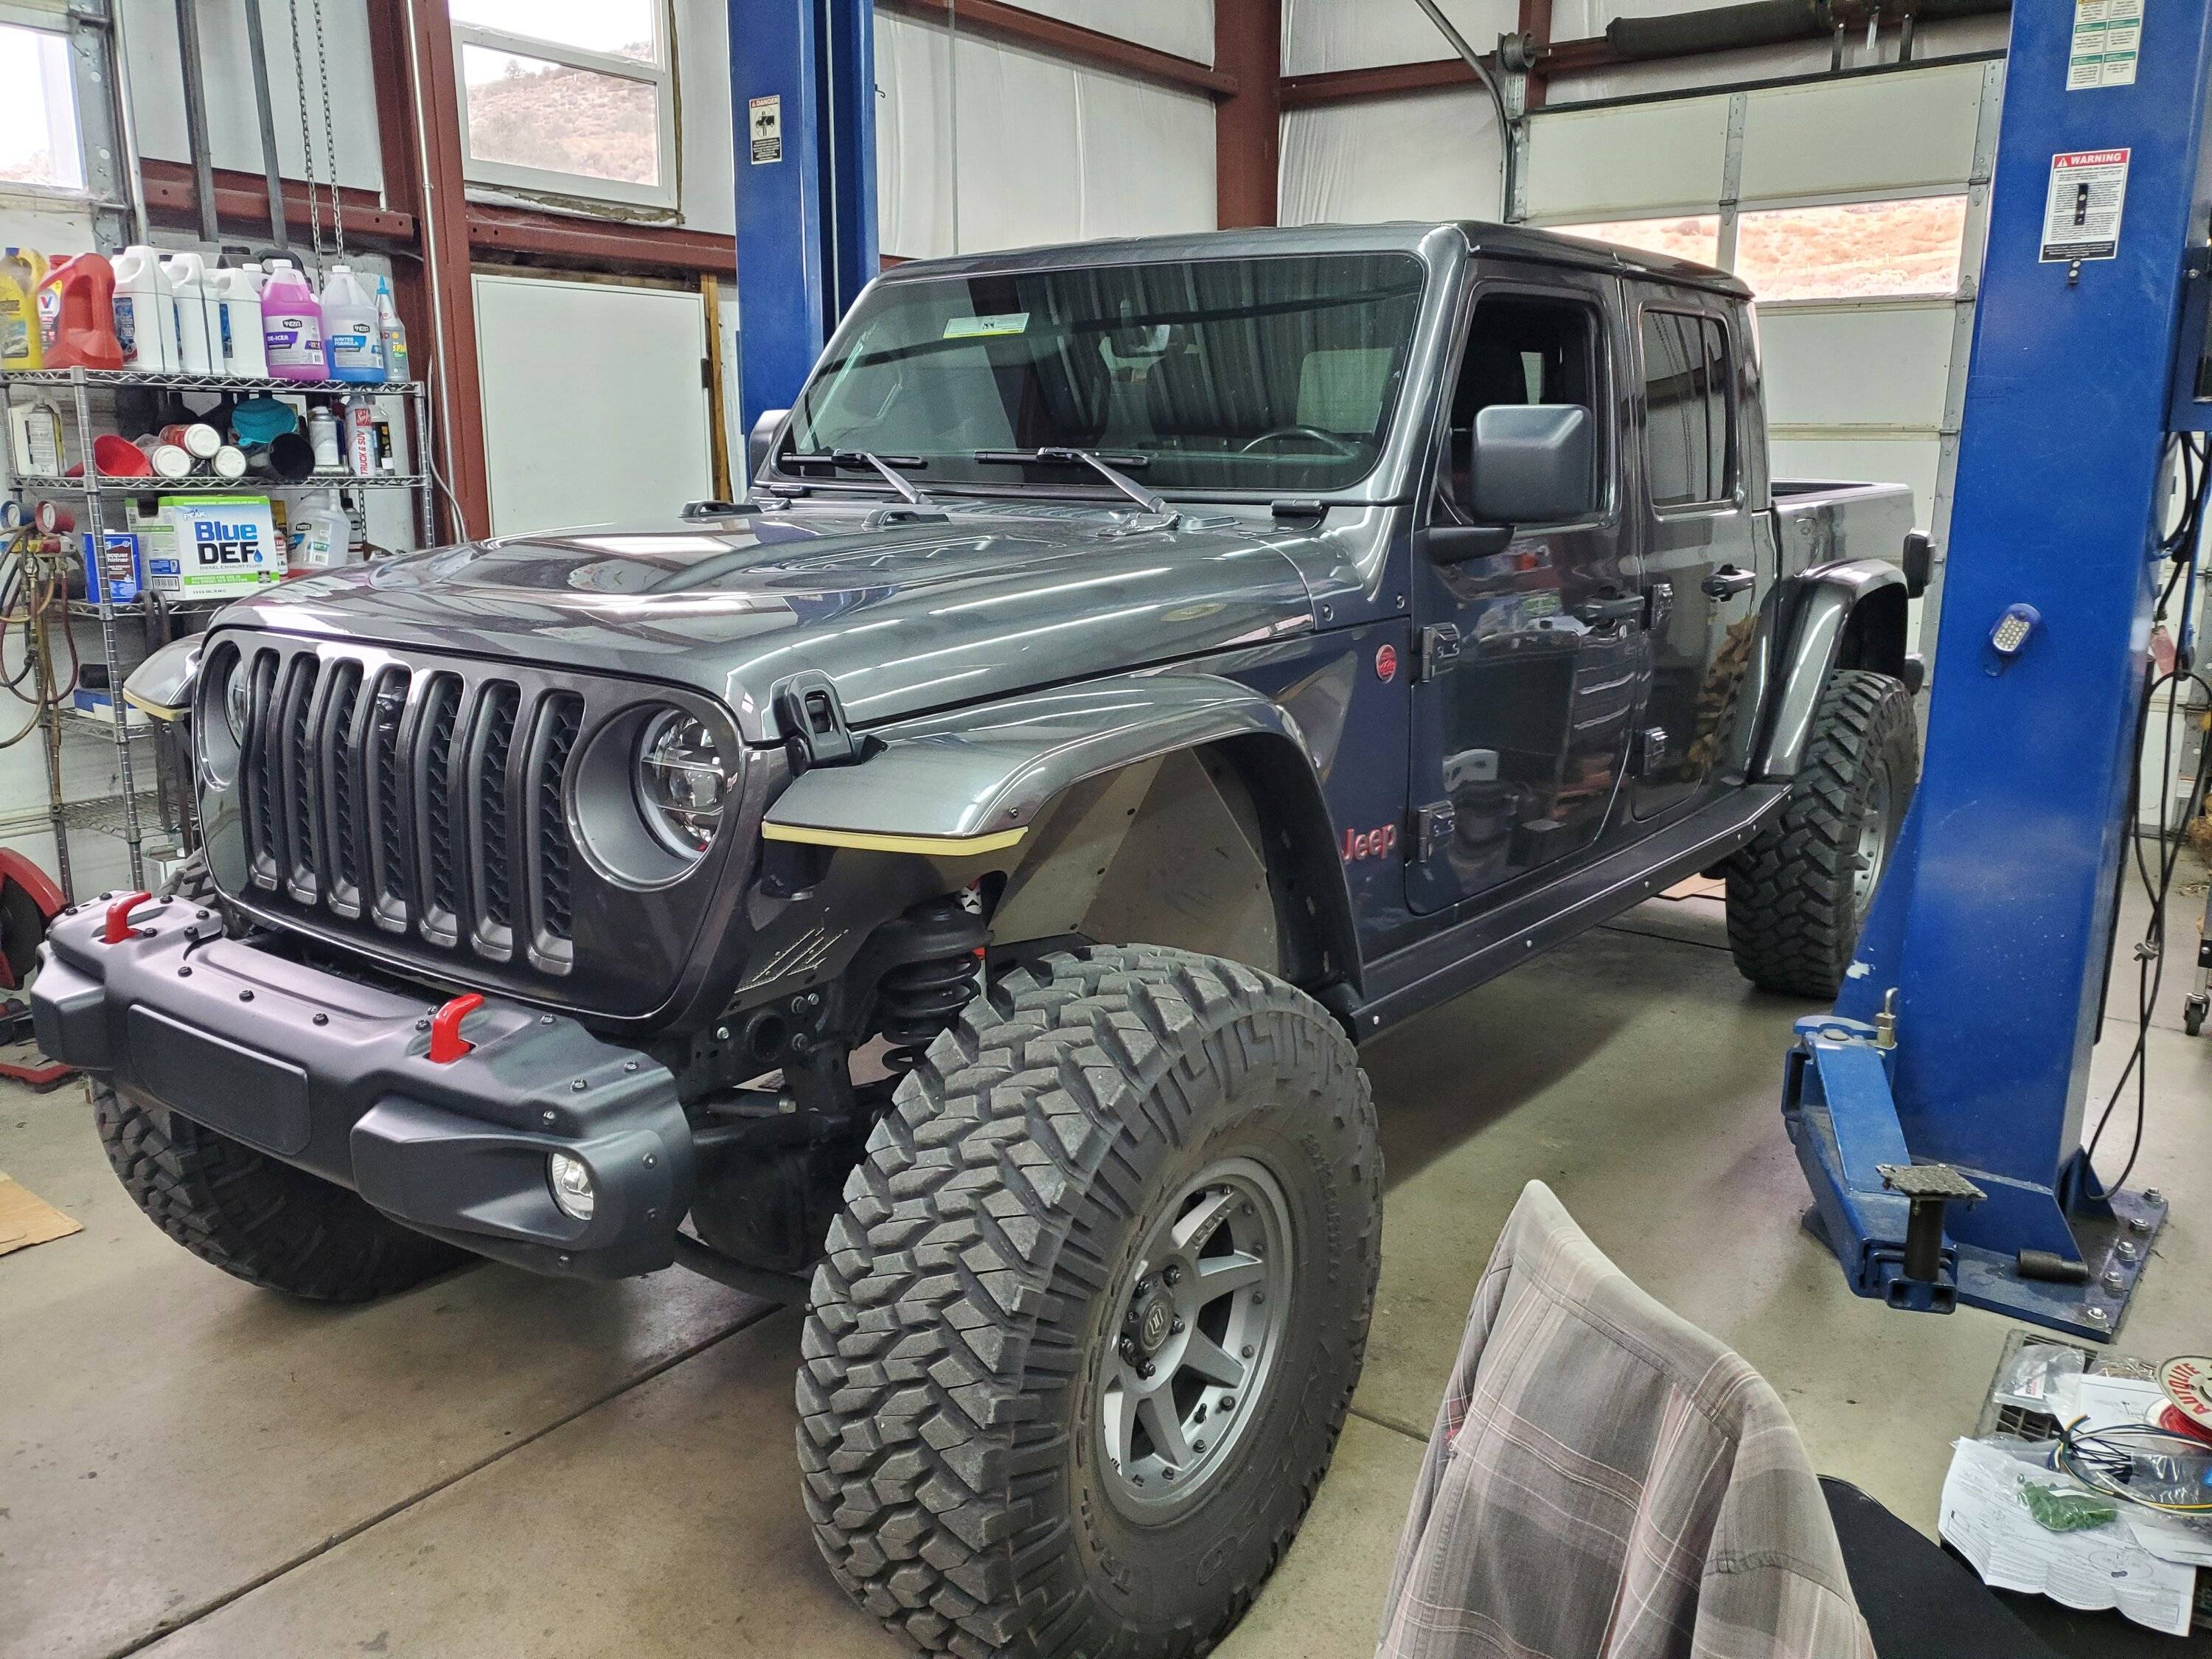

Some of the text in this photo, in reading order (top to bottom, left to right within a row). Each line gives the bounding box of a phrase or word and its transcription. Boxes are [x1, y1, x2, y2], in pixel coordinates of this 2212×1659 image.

[756, 97, 779, 106] DANGER
[2070, 153, 2121, 164] WARNING
[357, 430, 366, 445] SUV
[359, 452, 369, 475] TRUCK
[184, 510, 206, 521] PEAK
[194, 521, 257, 541] Blue
[197, 541, 258, 565] DEF
[1341, 823, 1397, 865] Jeep
[1190, 1203, 1231, 1250] ICON
[2168, 1363, 2212, 1416] AUTOLITE
